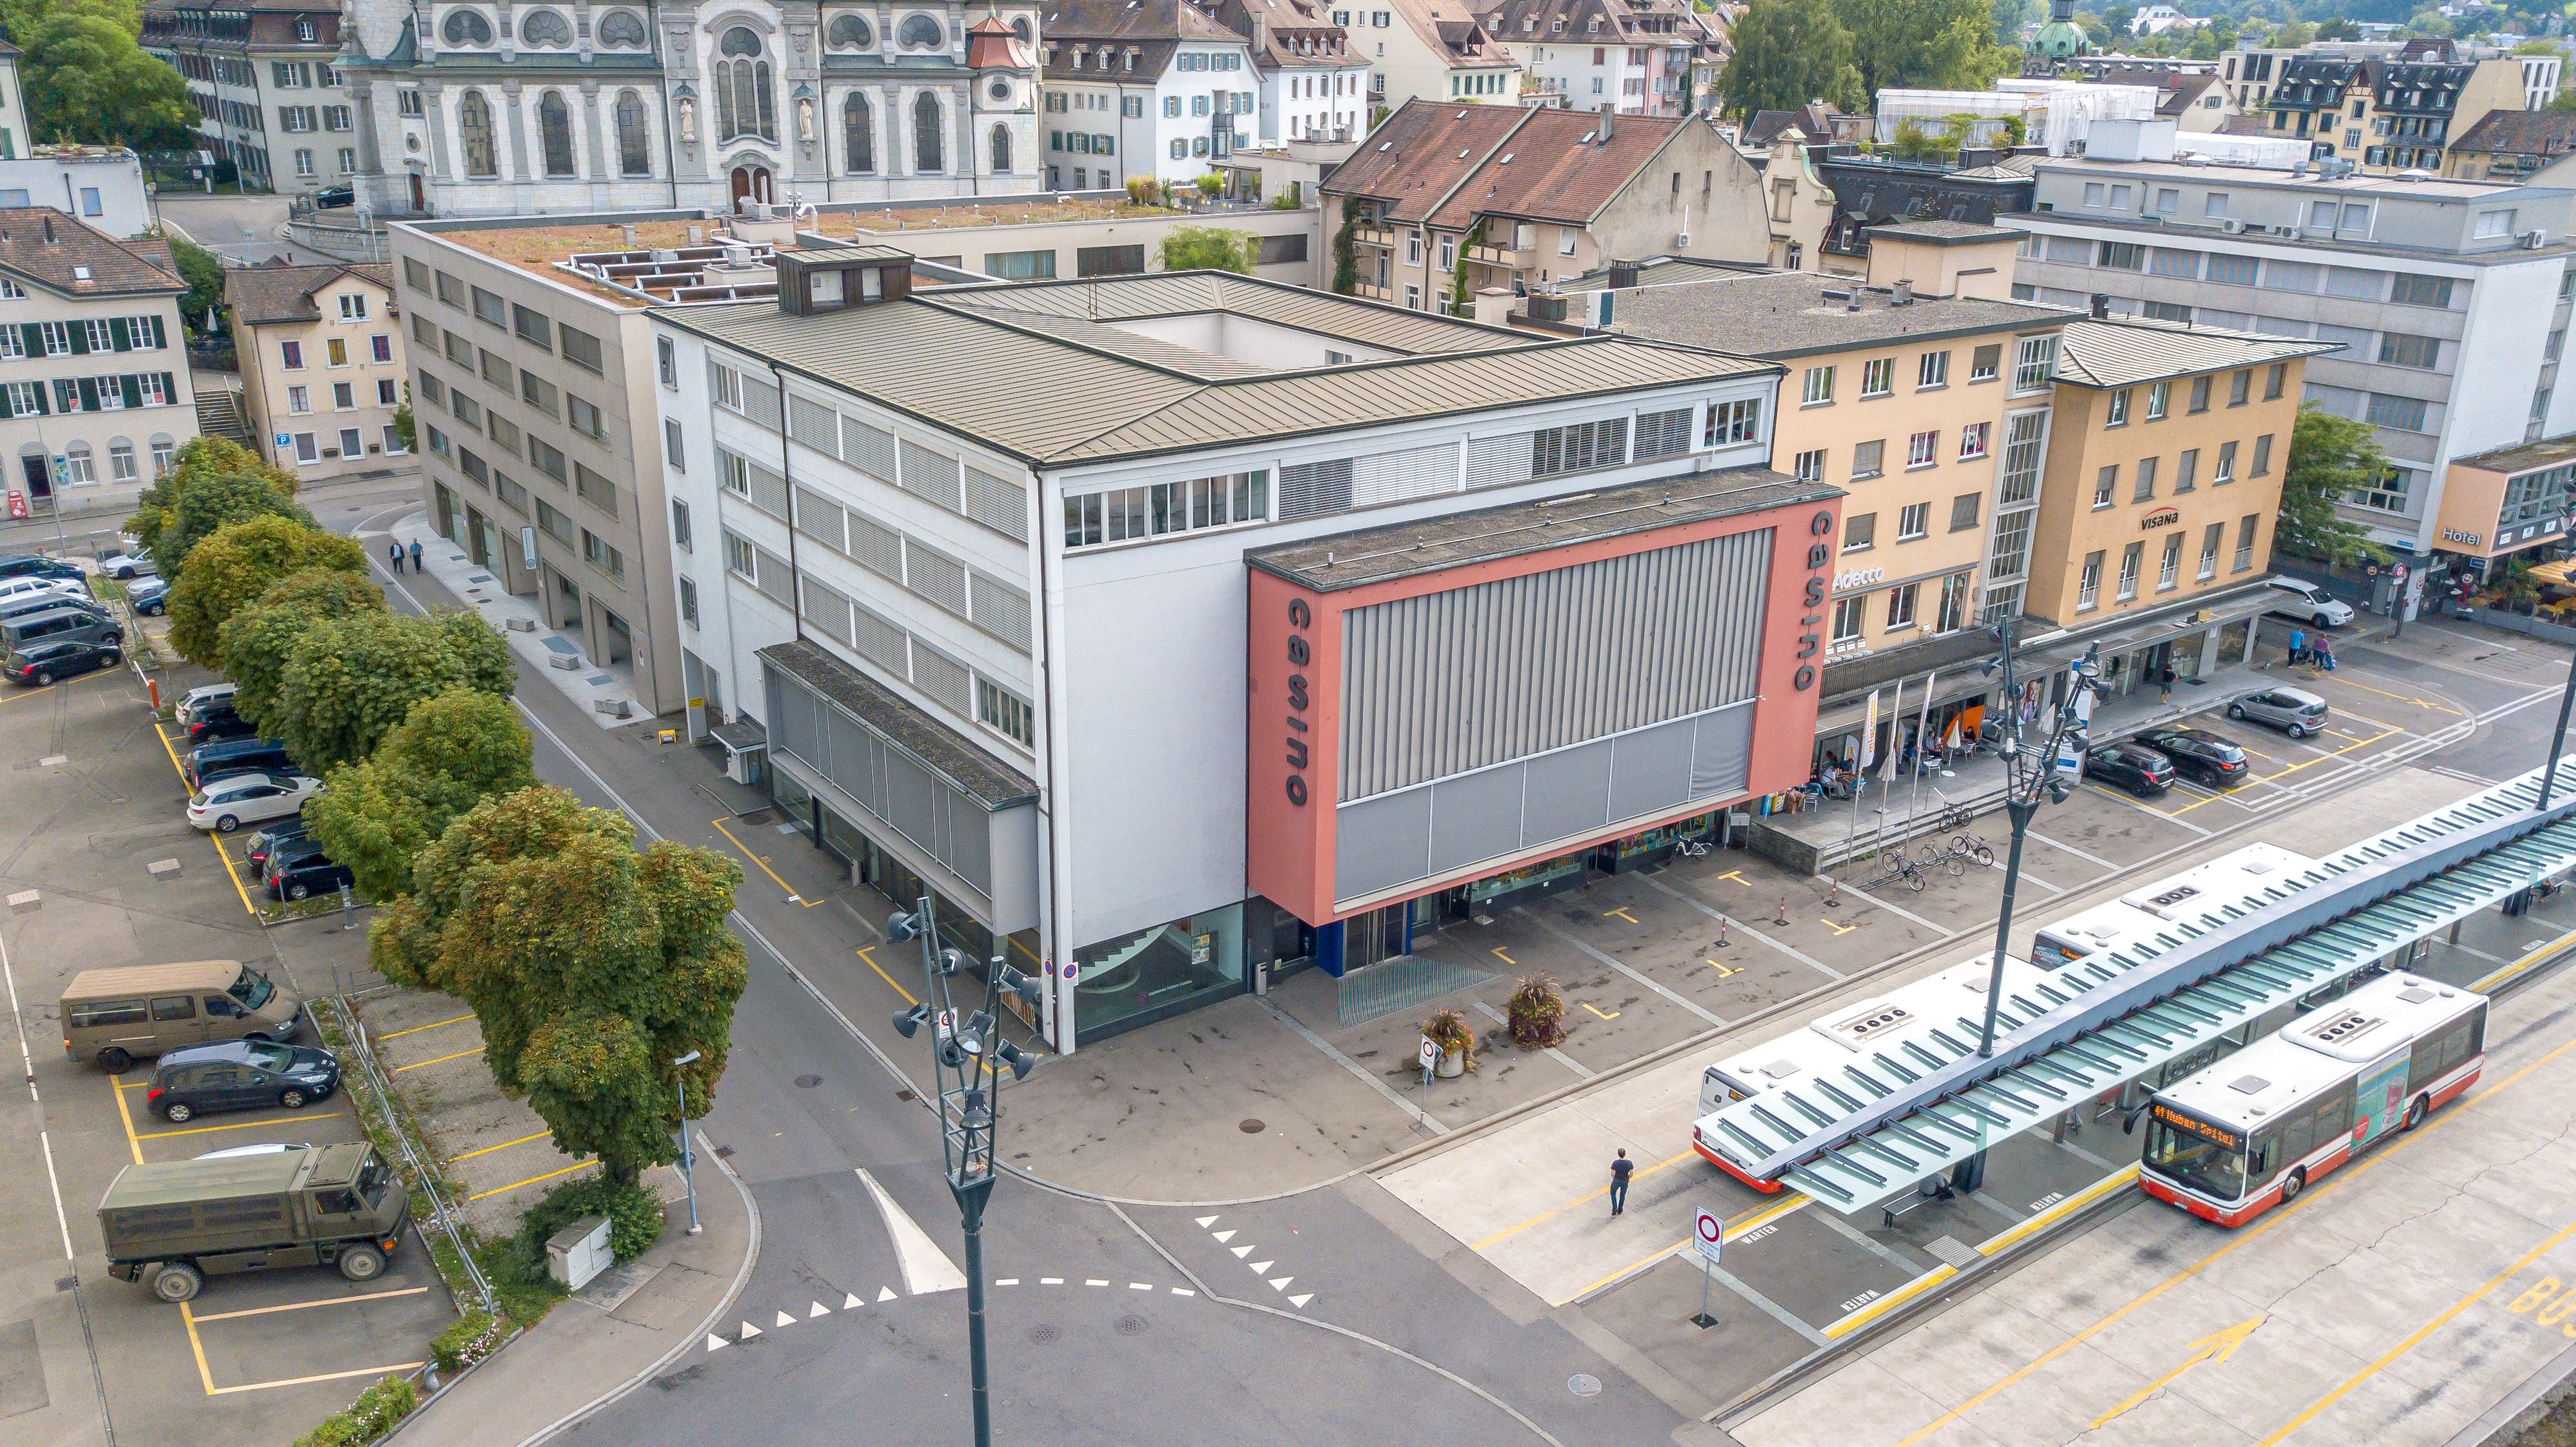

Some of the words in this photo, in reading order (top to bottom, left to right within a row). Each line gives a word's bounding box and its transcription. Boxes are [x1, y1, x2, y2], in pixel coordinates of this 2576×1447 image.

[2442, 527, 2481, 546] Hotel
[1831, 567, 1885, 591] Adecco
[1795, 511, 1833, 691] casino
[1285, 598, 1311, 806] casino
[2029, 1191, 2064, 1211] WARTEN
[1739, 1224, 1779, 1244] WARTEN
[1840, 1289, 1880, 1311] WARTEN
